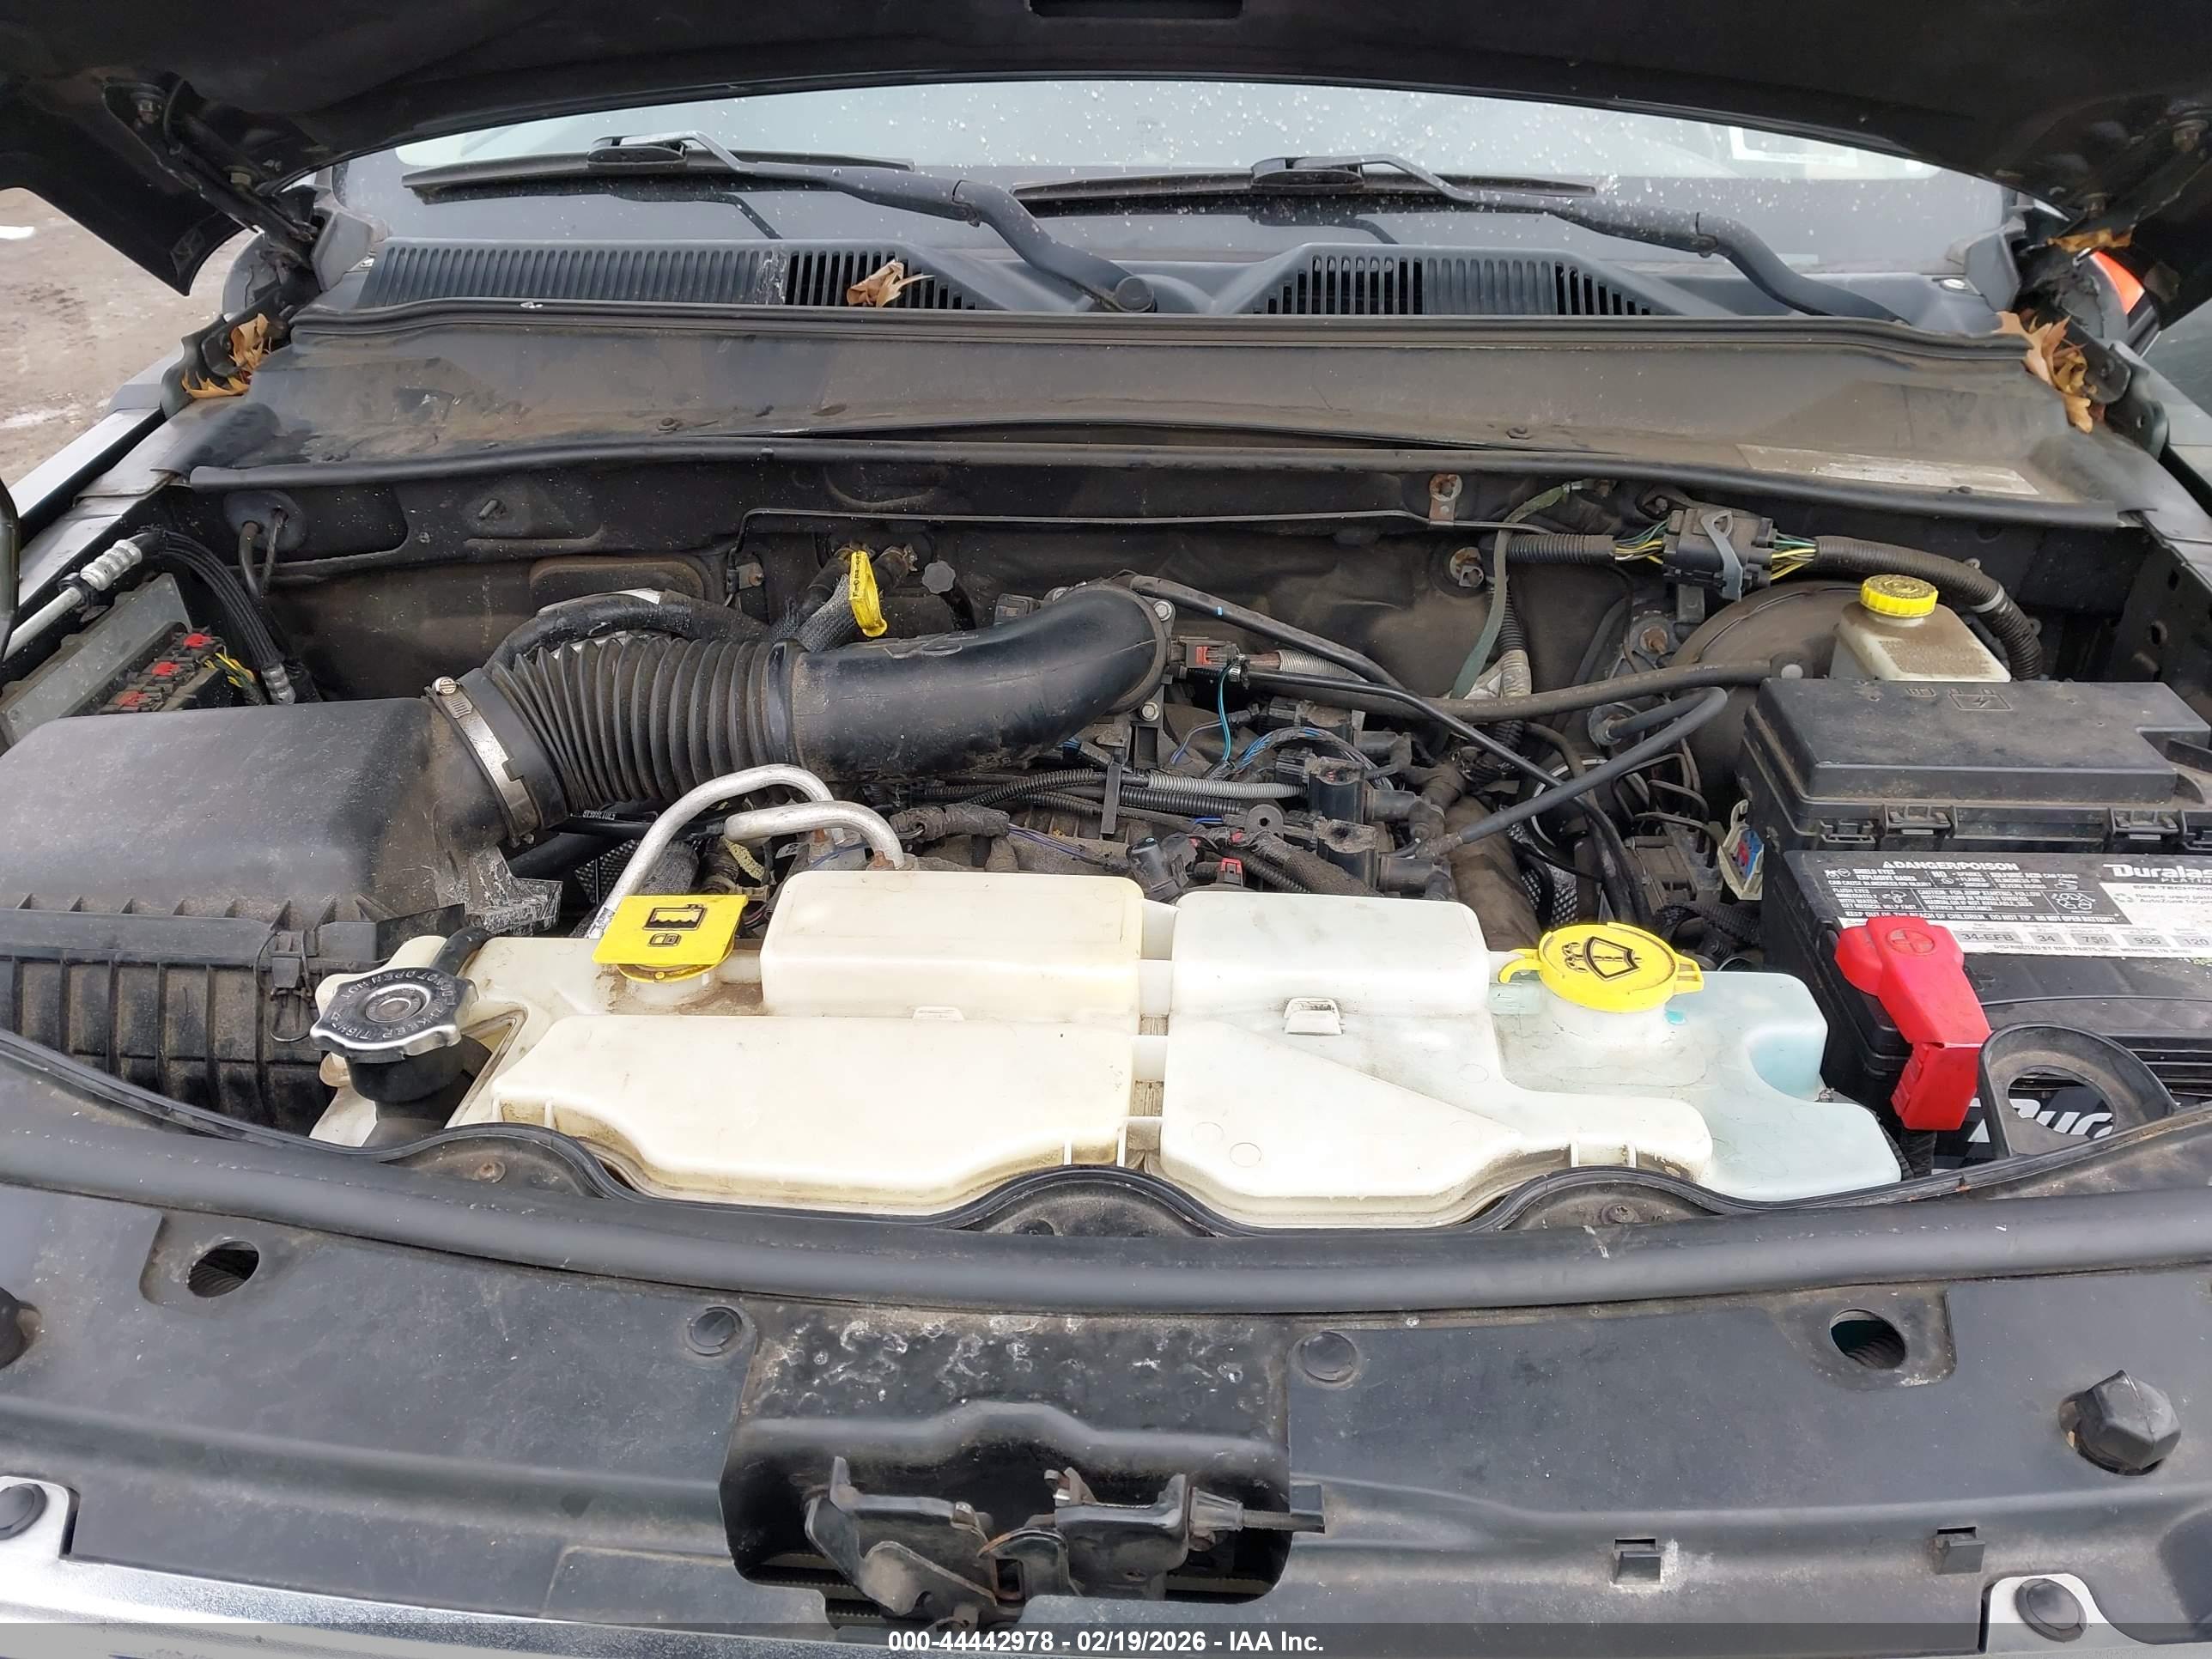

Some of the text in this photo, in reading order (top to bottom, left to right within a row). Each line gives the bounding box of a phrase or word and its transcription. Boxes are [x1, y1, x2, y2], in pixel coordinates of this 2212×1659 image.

[1895, 861, 2020, 871] DANGER/POISON
[1961, 933, 2014, 941] 34-EFB
[371, 969, 416, 985] OPEN
[340, 981, 369, 1000] HOT
